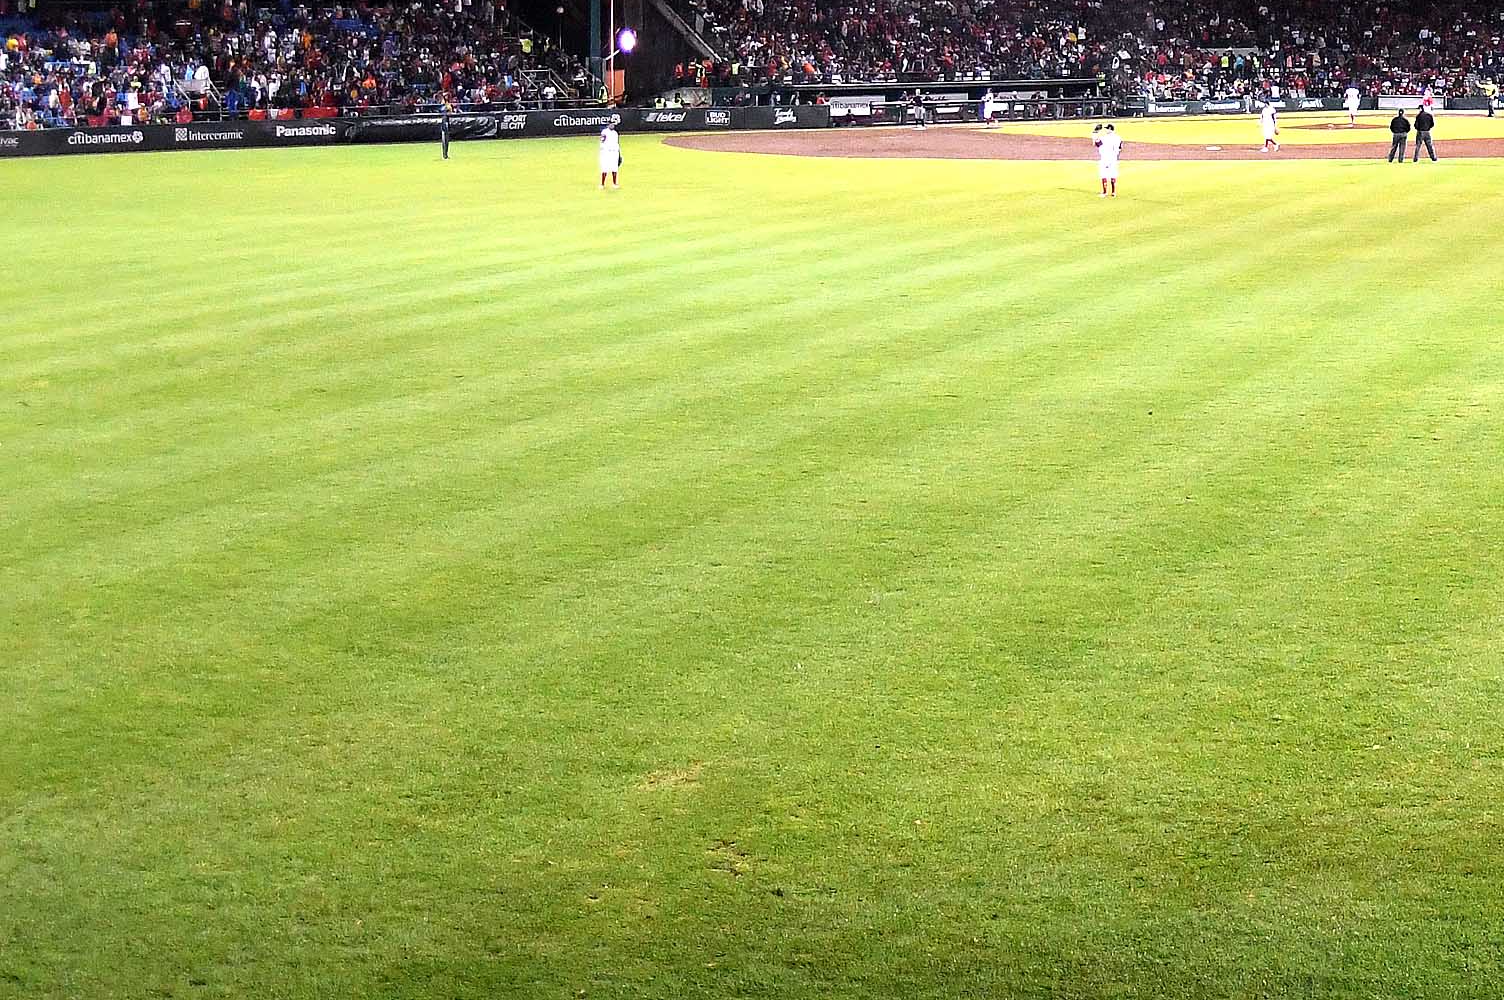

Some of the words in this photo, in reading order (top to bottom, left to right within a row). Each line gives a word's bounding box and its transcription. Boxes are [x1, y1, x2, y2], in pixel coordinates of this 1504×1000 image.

[656, 112, 687, 122] telcel
[275, 123, 337, 137] Panasonic
[509, 122, 525, 130] CITY
[67, 131, 133, 145] citibanamex
[189, 128, 244, 141] Interceramic
